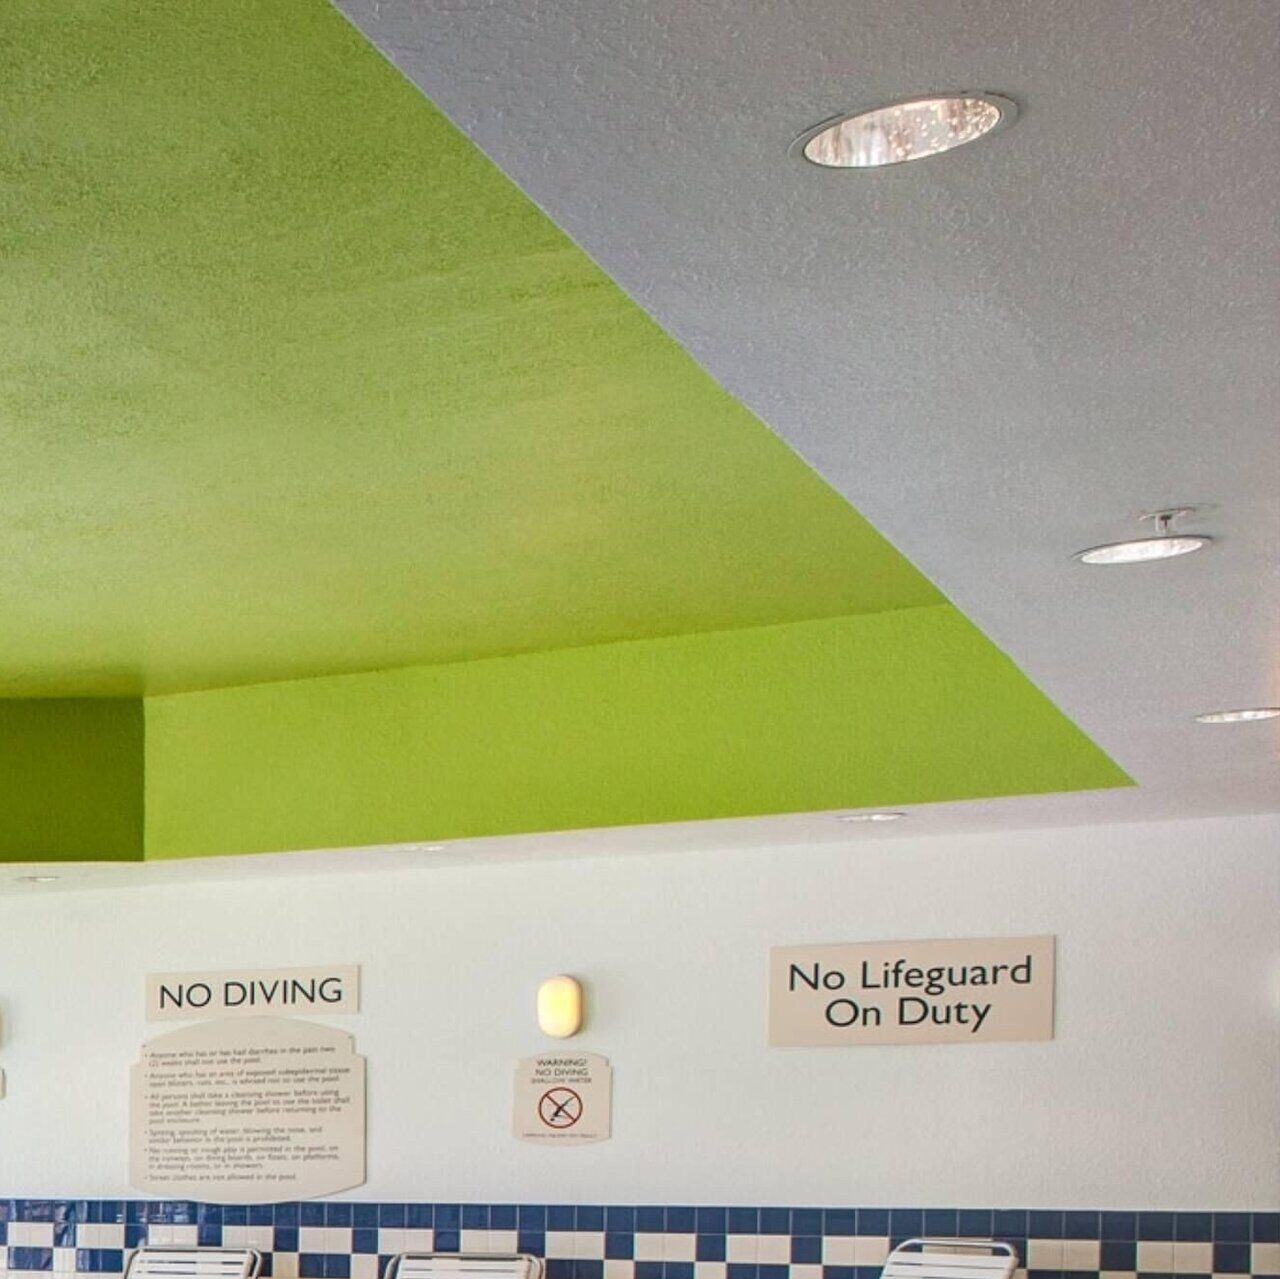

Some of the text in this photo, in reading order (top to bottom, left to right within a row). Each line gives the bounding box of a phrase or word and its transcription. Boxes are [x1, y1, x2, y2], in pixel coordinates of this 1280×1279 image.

[789, 955, 1032, 996] No Lifeguard
[160, 977, 343, 1009] NO DIVING
[826, 996, 992, 1033] On Duty
[535, 1067, 589, 1076] NO DIVING
